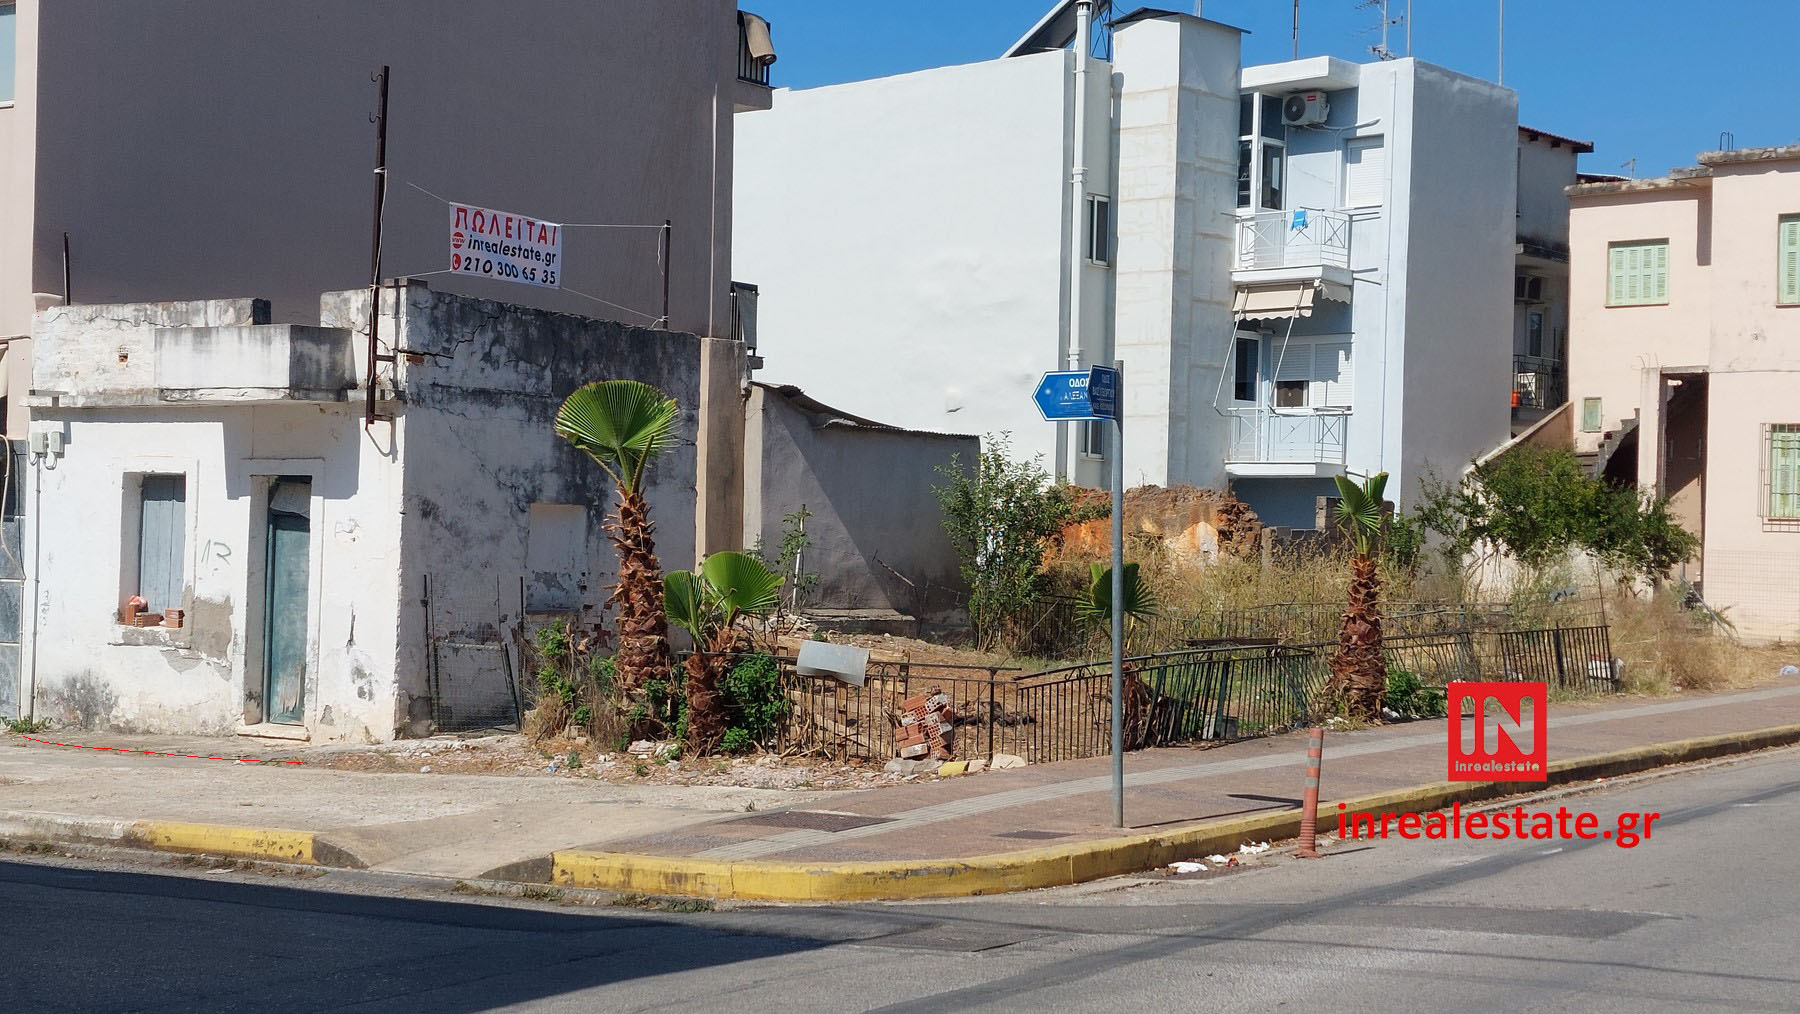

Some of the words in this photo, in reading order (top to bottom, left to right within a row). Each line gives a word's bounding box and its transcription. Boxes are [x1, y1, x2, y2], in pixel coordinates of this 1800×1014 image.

[455, 207, 557, 246] ΠΩΛΕΙΤΑΙ
[468, 234, 556, 267] inrealestate.gr
[463, 256, 493, 274] 210
[497, 261, 519, 279] 300
[522, 266, 537, 282] 65
[541, 269, 556, 285] 35
